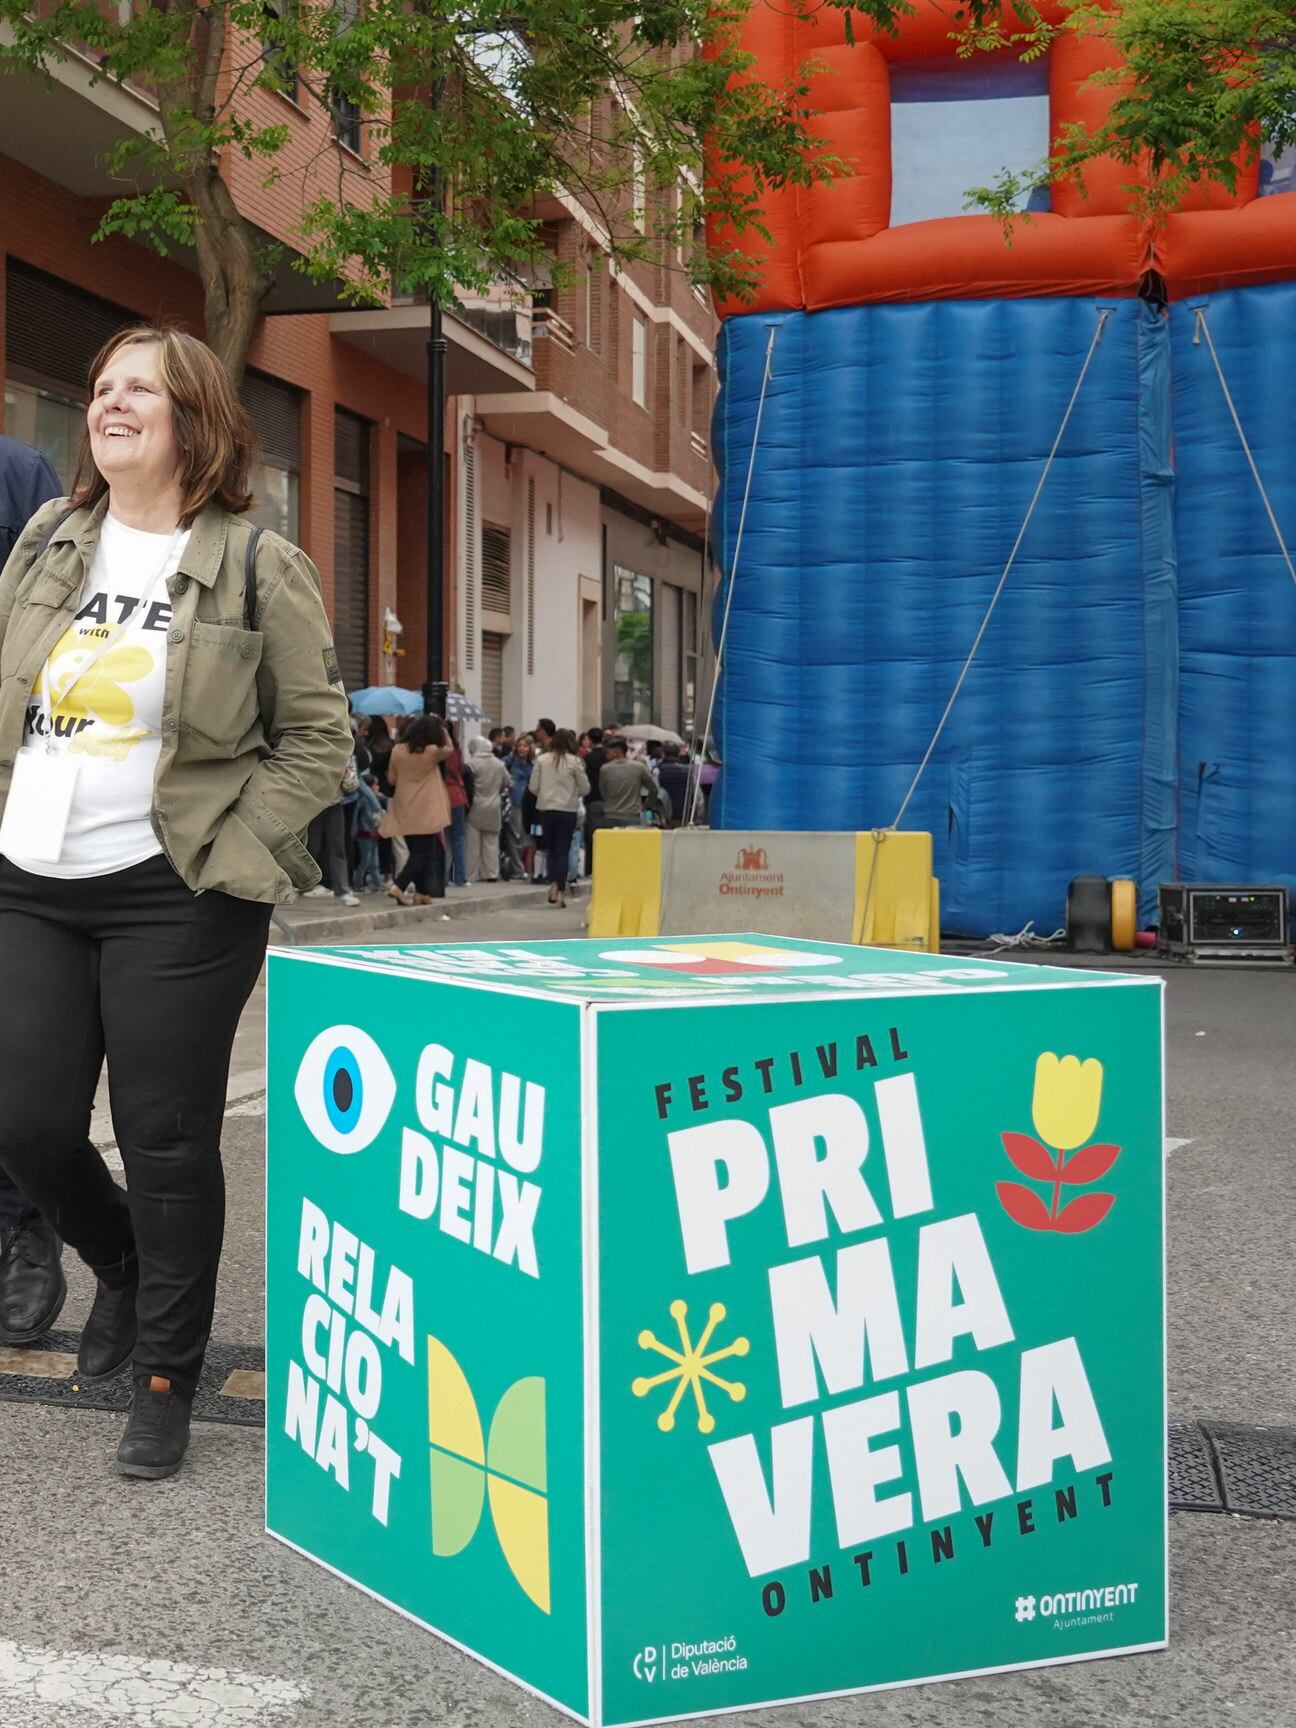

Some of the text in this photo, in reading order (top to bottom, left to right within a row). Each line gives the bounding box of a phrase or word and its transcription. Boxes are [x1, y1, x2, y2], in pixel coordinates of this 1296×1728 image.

[79, 627, 110, 639] with
[719, 883, 784, 898] Ontinyent
[415, 1043, 545, 1173] GAU
[655, 1027, 909, 1119] FESTIVAL
[398, 1126, 542, 1279] DEIX
[667, 1072, 934, 1275] PRI
[297, 1196, 415, 1367] RELA
[768, 1212, 1016, 1409] MA
[302, 1294, 382, 1420] CIO
[707, 1337, 1113, 1578] VERA
[761, 1472, 1115, 1617] ONTINYENT
[671, 1635, 736, 1660] Diputació
[671, 1655, 749, 1679] de València
[1053, 1612, 1114, 1631] Ajuntament
